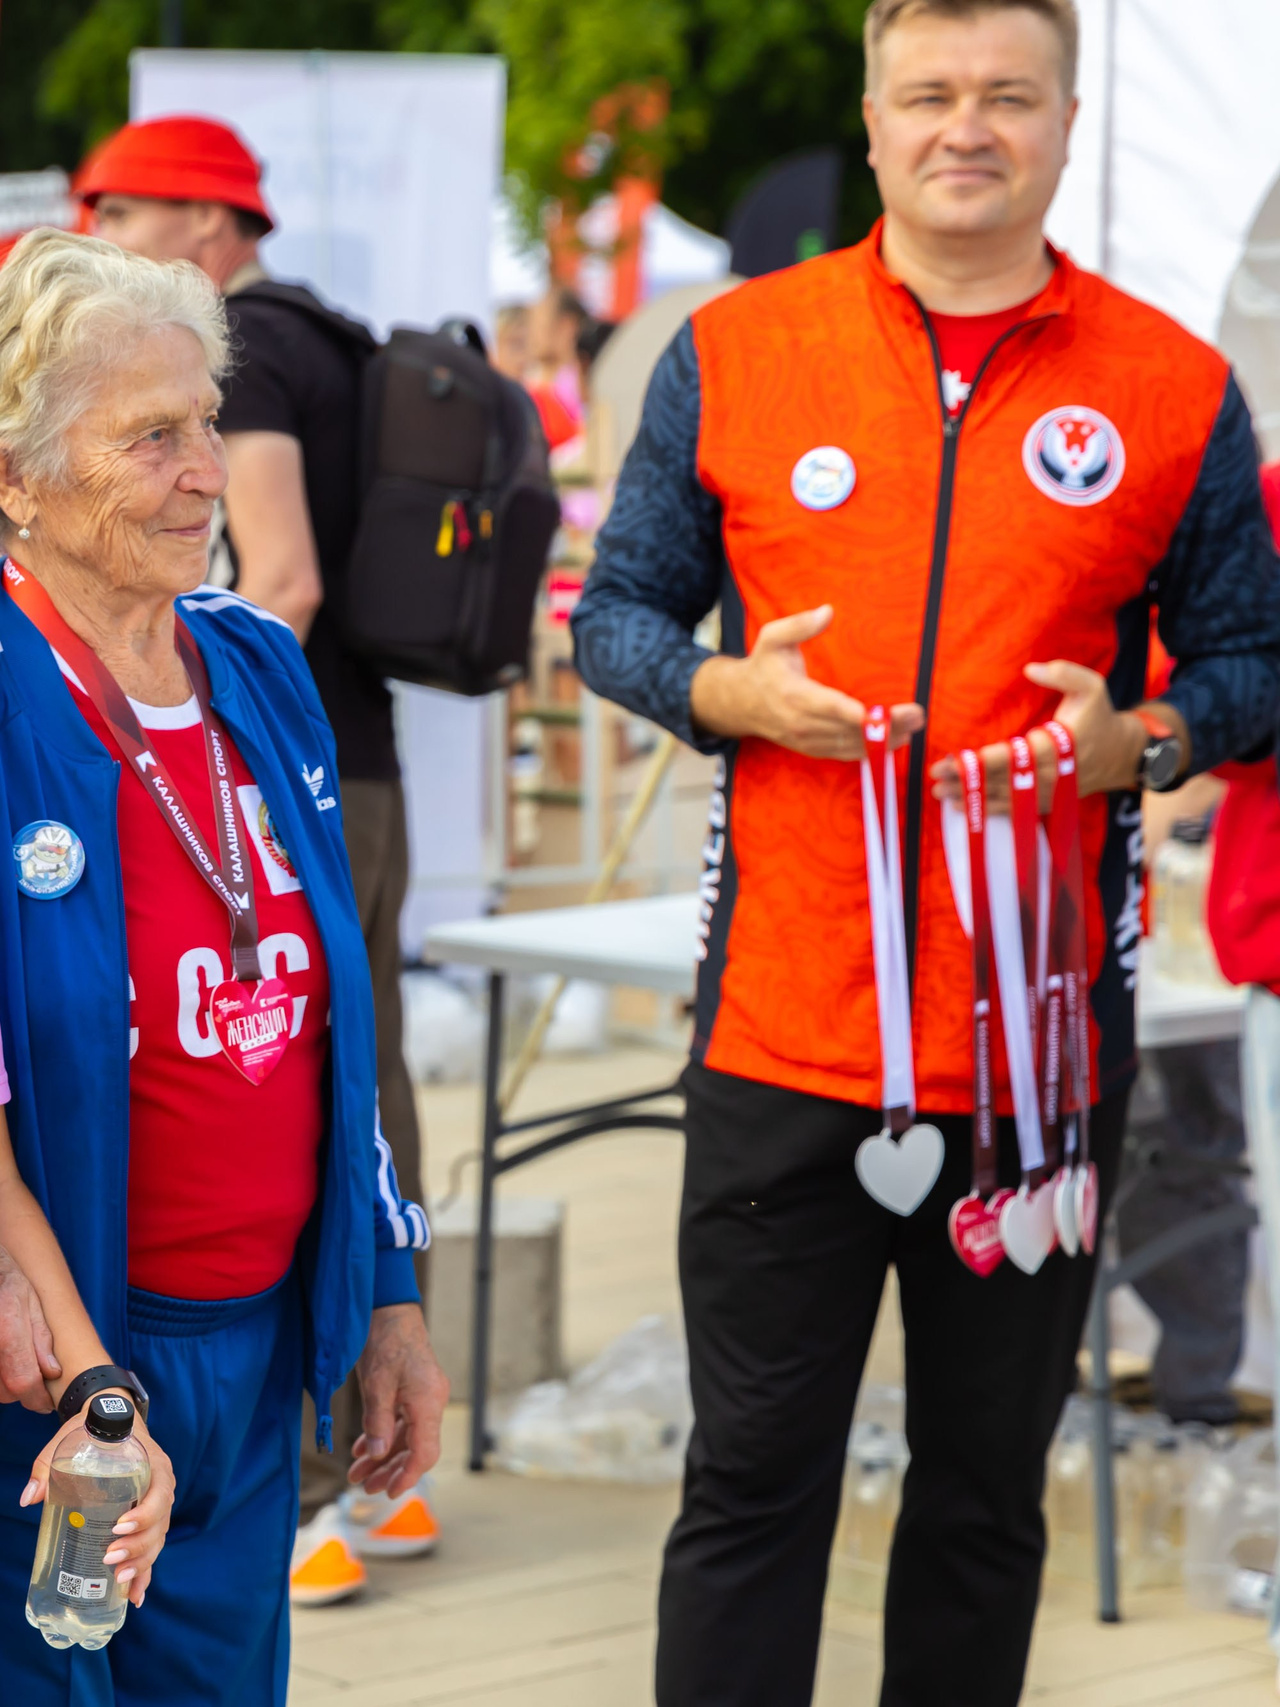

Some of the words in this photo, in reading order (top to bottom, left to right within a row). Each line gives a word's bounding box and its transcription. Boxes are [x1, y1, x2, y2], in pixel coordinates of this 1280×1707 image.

[210, 729, 227, 777] СПОРТ
[152, 776, 214, 873] КАЛАШНИКОВ
[212, 874, 244, 916] СПОРТ
[219, 779, 245, 882] КАЛАШНИКОВ
